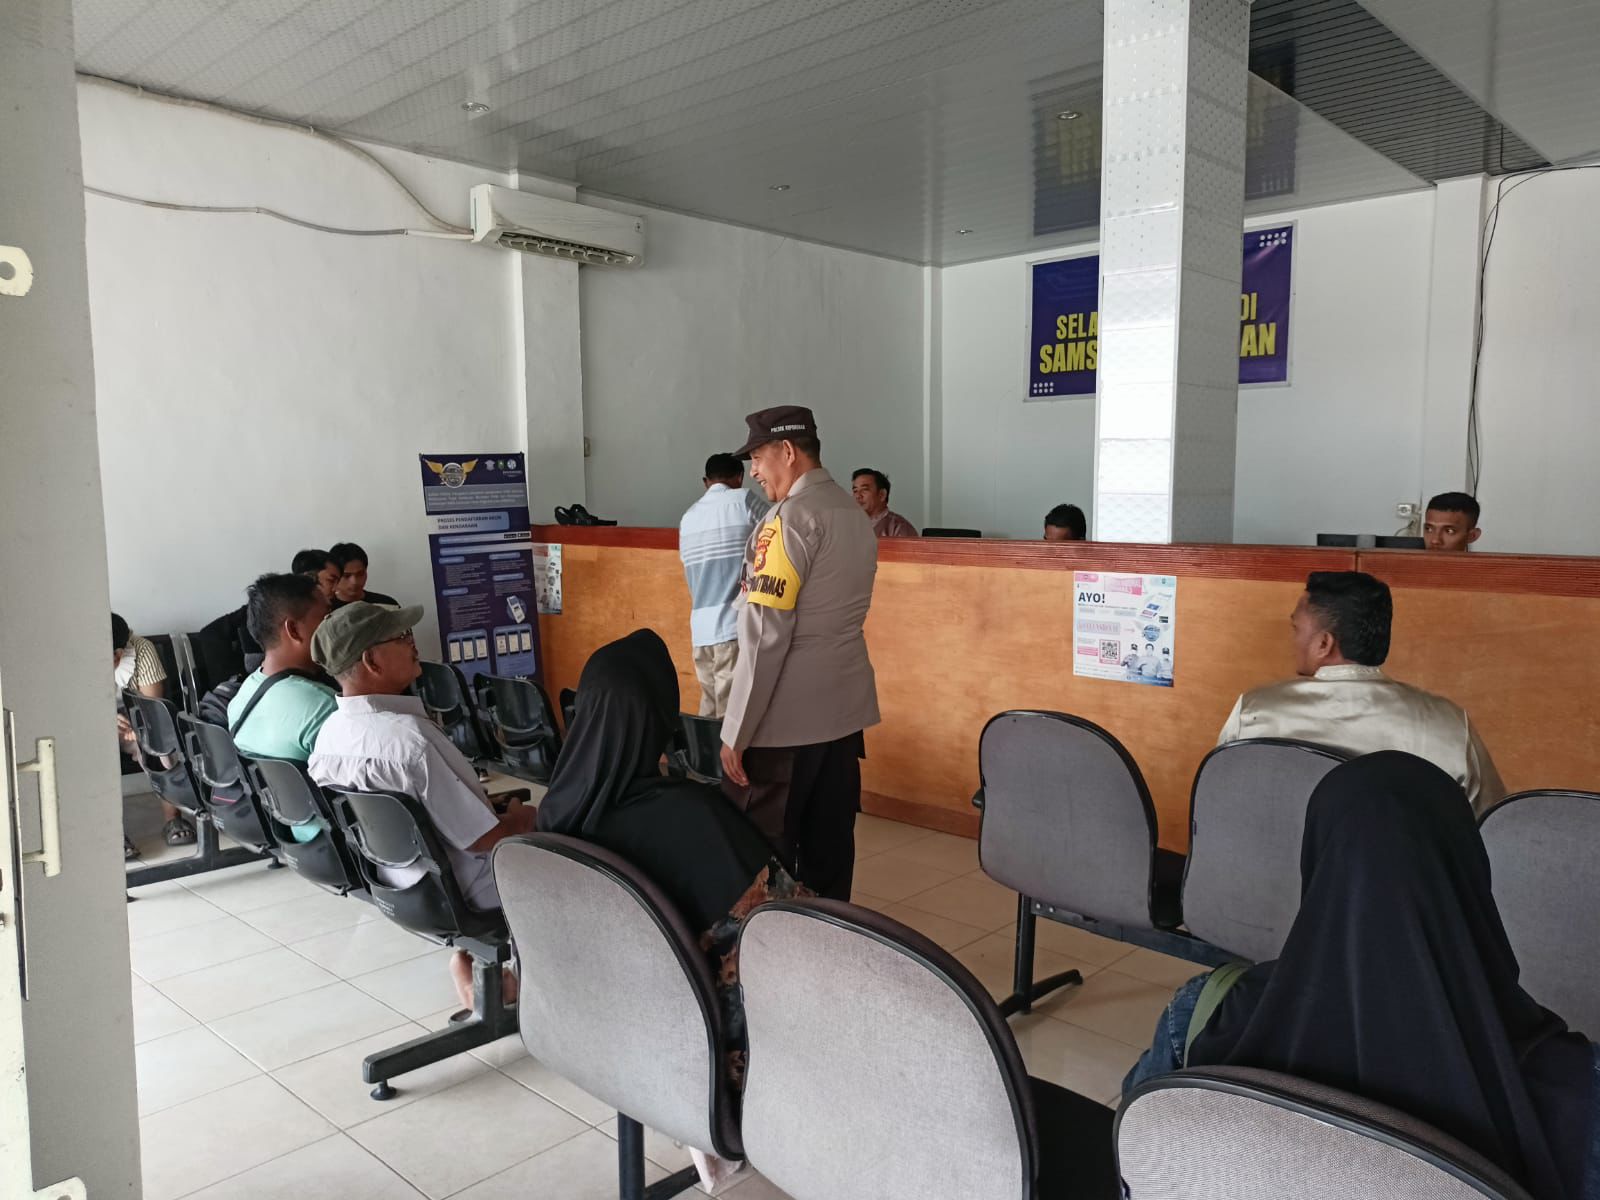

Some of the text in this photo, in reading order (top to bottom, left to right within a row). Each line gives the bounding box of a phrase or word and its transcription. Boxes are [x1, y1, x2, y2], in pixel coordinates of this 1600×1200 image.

[1056, 311, 1098, 340] SELA
[1039, 322, 1277, 374] SAMS AN
[1078, 592, 1105, 604] AYO!
